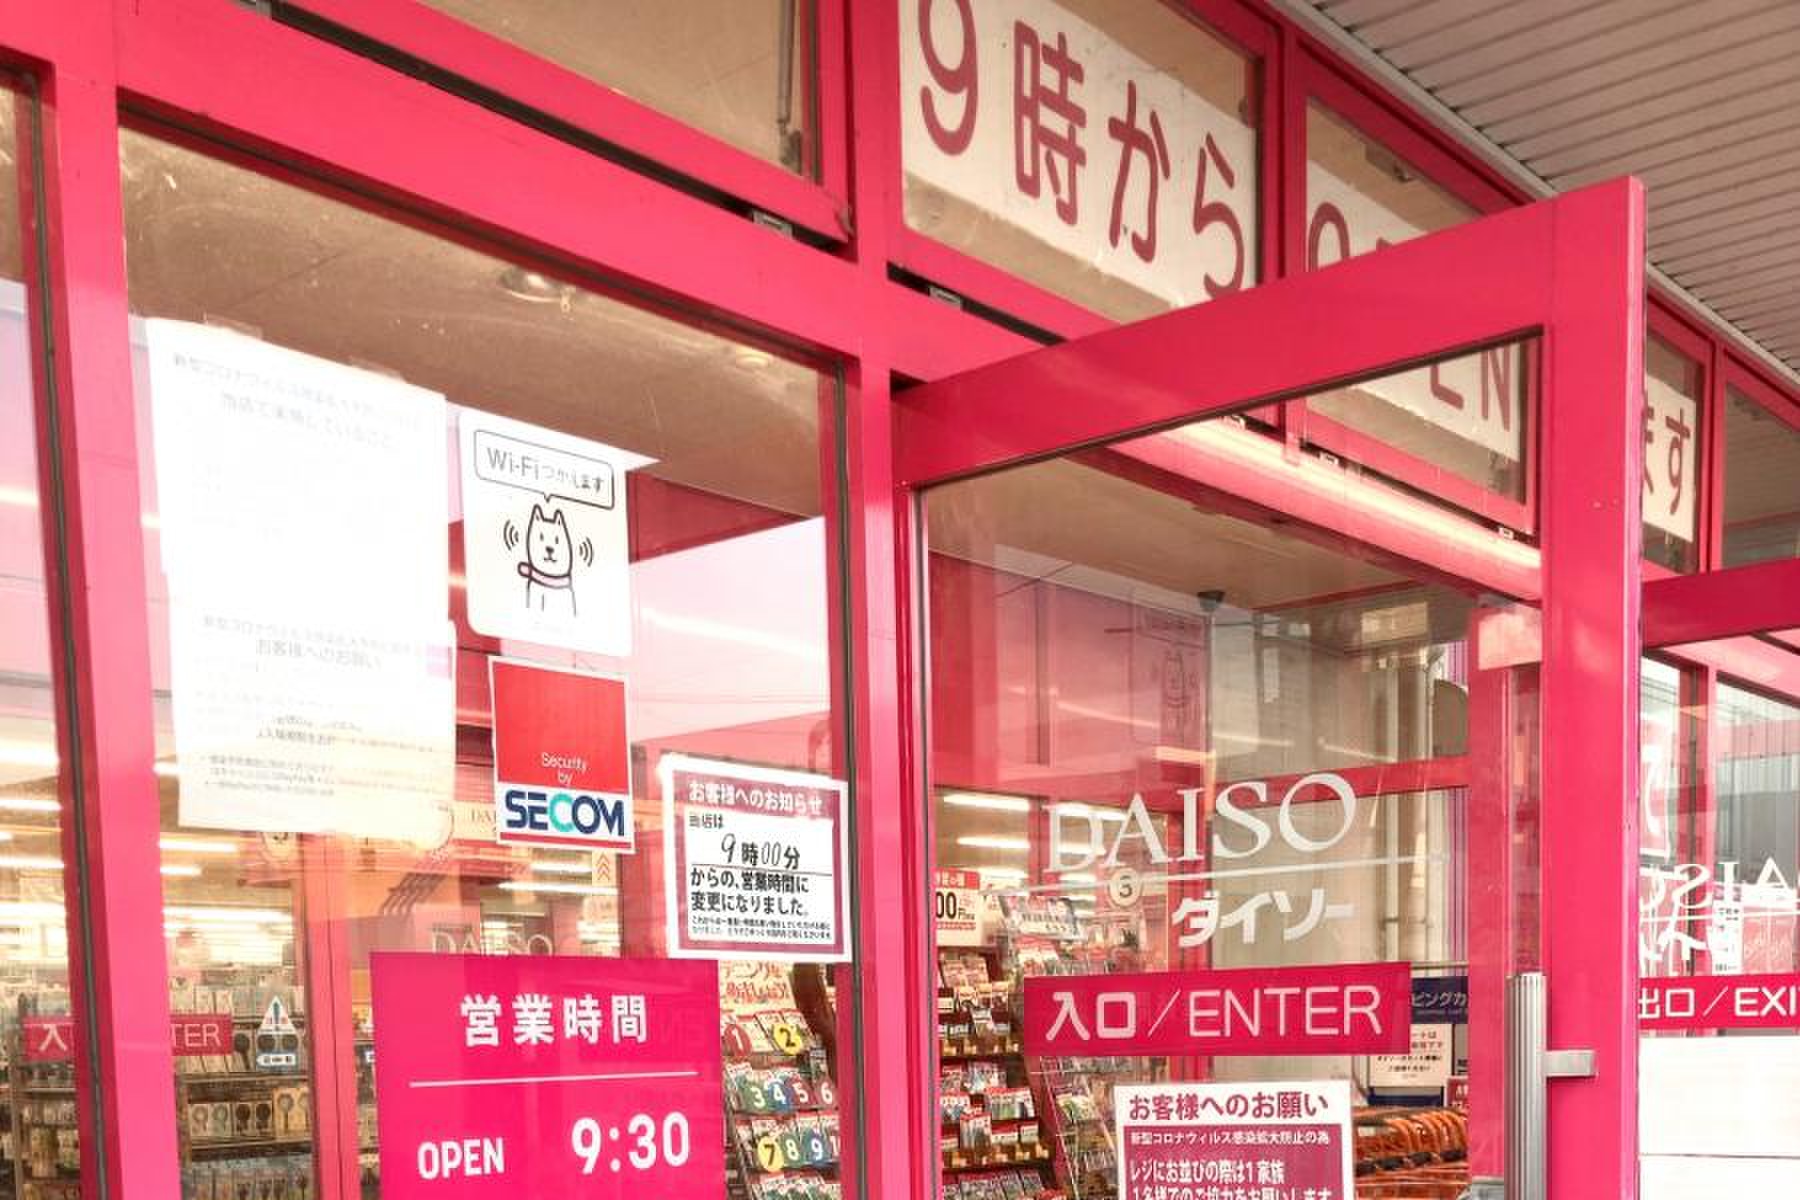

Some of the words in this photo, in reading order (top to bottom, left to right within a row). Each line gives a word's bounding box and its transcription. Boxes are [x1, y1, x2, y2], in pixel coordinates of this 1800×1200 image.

[919, 0, 1244, 299] 9時から
[541, 752, 588, 773] Security
[557, 771, 573, 786] by
[505, 789, 625, 837] SECOM
[689, 782, 823, 815] お客様へのお知らせ
[1043, 773, 1357, 873] DAISO
[691, 891, 808, 916] 変更になりました。
[1172, 888, 1354, 947] ダイソー
[460, 993, 648, 1048] 営業時間
[1129, 1091, 1329, 1121] お客様へのお願い
[418, 1137, 505, 1179] OPEN
[571, 1111, 690, 1174] 9:30
